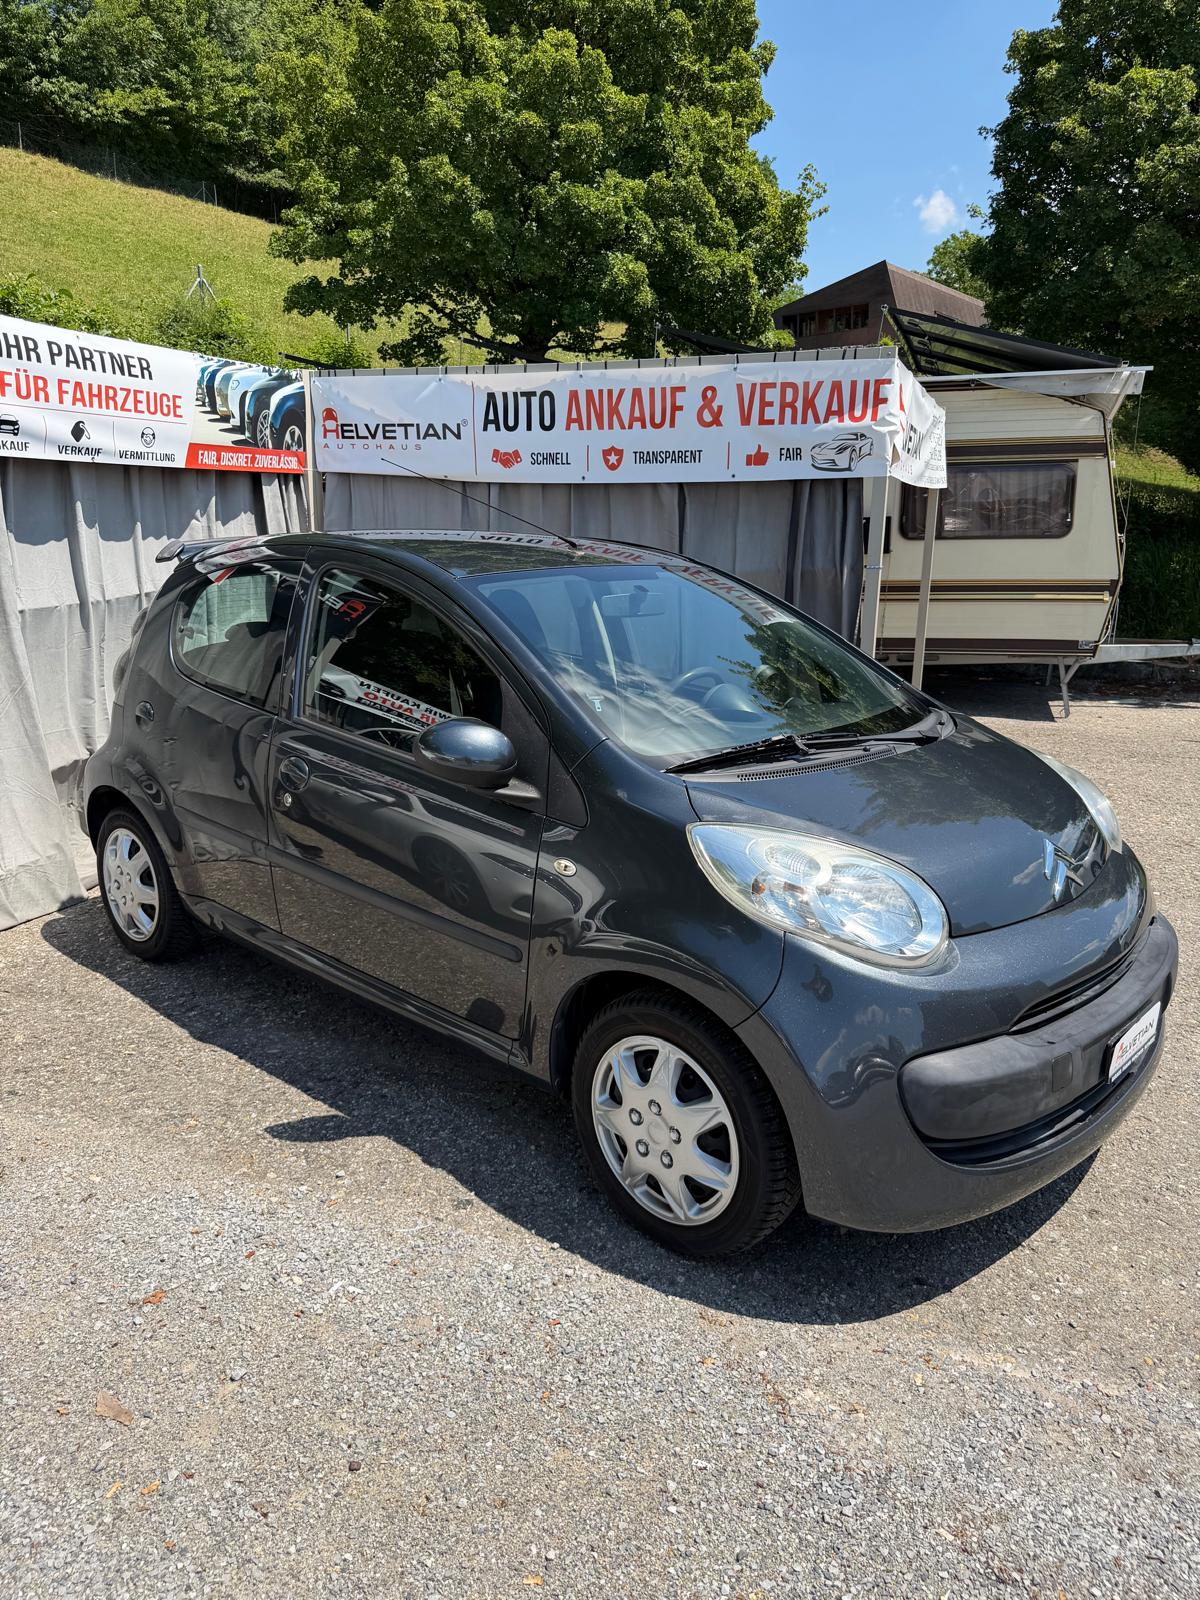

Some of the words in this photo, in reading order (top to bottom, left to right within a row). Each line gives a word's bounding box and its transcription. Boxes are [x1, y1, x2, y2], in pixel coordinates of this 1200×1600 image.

[46, 340, 153, 381] PARTNER
[0, 367, 50, 403] FÜR
[57, 378, 184, 419] FAHRZEUGE
[482, 390, 556, 432] AUTO
[565, 385, 686, 431] ANKAUF
[696, 385, 723, 429] &
[736, 378, 895, 427] VERKAUF
[57, 444, 103, 457] VERKAUF
[323, 442, 422, 451] AUTOHAUS
[778, 446, 803, 463] FAIR
[118, 450, 176, 463] VERMITTLUNG
[220, 451, 253, 467] DISKRET.
[254, 453, 300, 469] ZUVERLÄSSIG.
[530, 451, 571, 467] SCHNELL
[632, 449, 703, 466] TRANSPARENT
